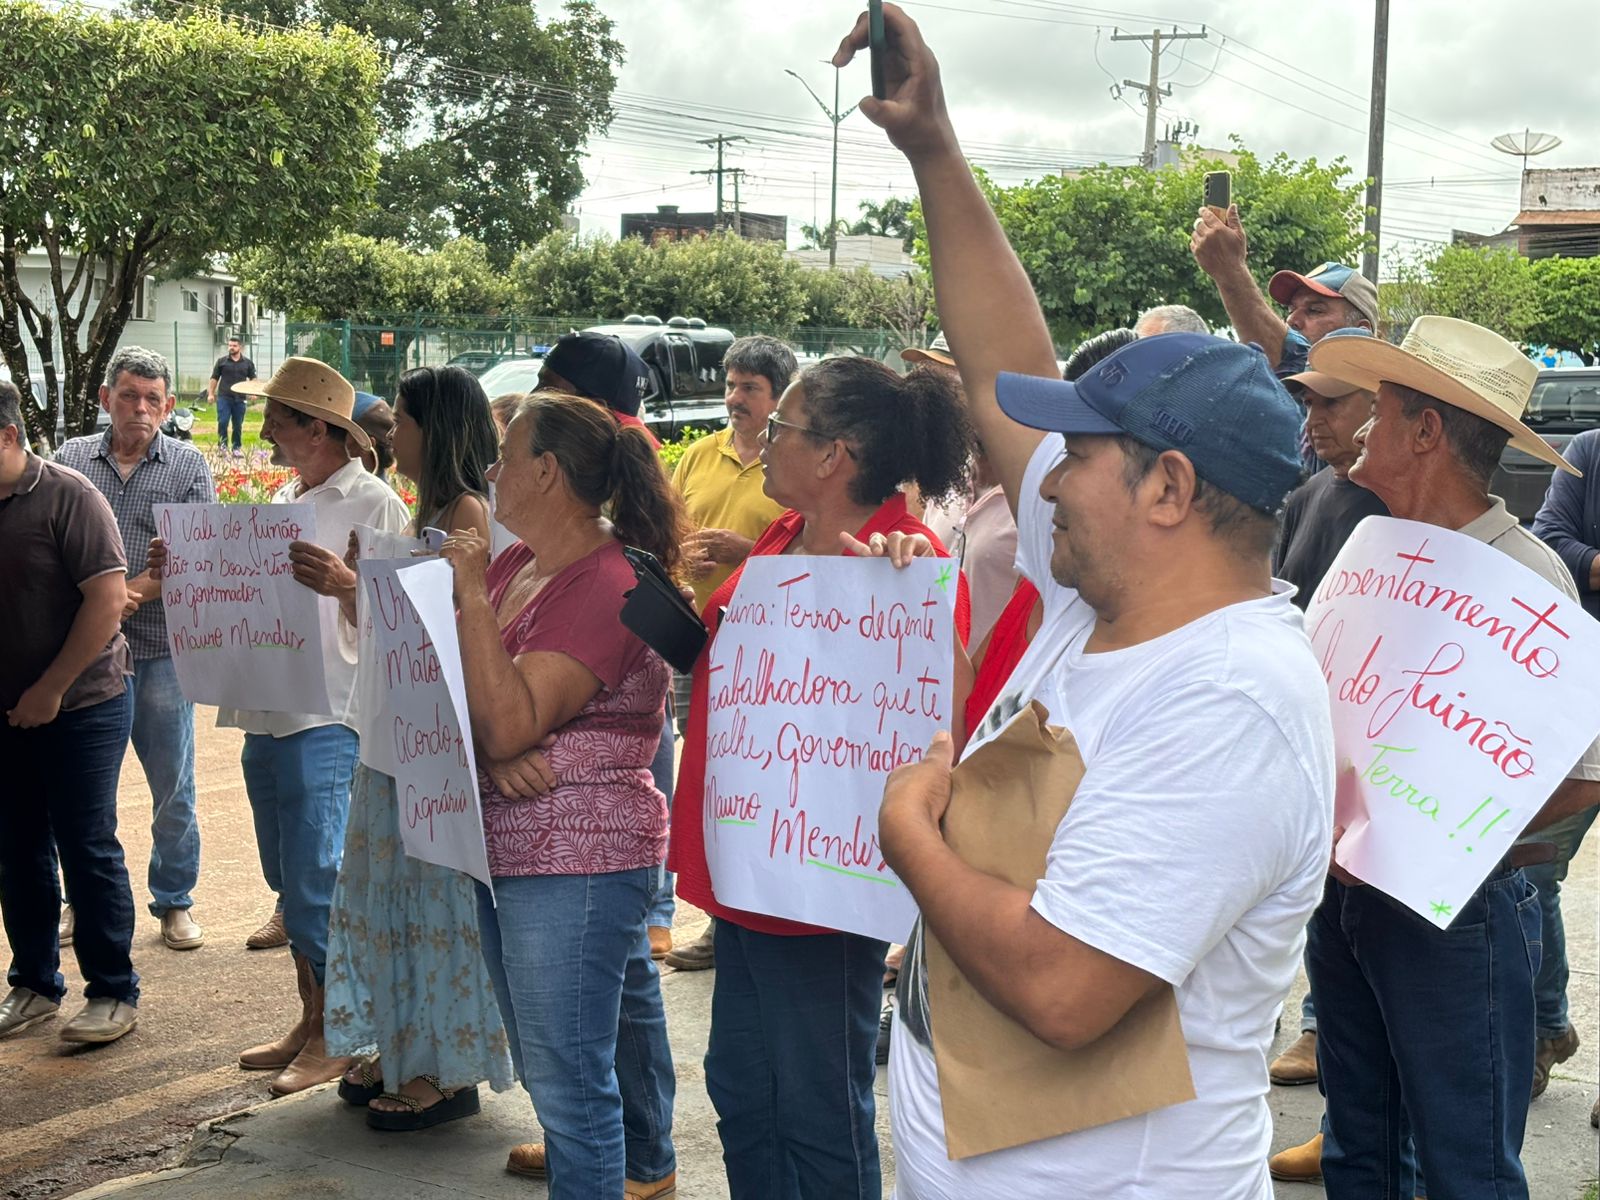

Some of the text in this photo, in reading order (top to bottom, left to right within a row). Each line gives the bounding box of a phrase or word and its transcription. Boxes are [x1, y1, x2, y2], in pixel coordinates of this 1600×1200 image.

[159, 506, 303, 568] O Vale do Juinão
[163, 555, 190, 578] dão
[195, 559, 214, 574] as
[166, 592, 183, 607] ao
[777, 573, 850, 632] Terra
[173, 617, 305, 656] Mauro Mendes
[386, 628, 441, 690] Mato
[873, 682, 916, 735] que
[917, 667, 942, 721] te
[1338, 634, 1381, 705] do
[1367, 642, 1535, 779] Juinão
[706, 775, 761, 846] Mauro
